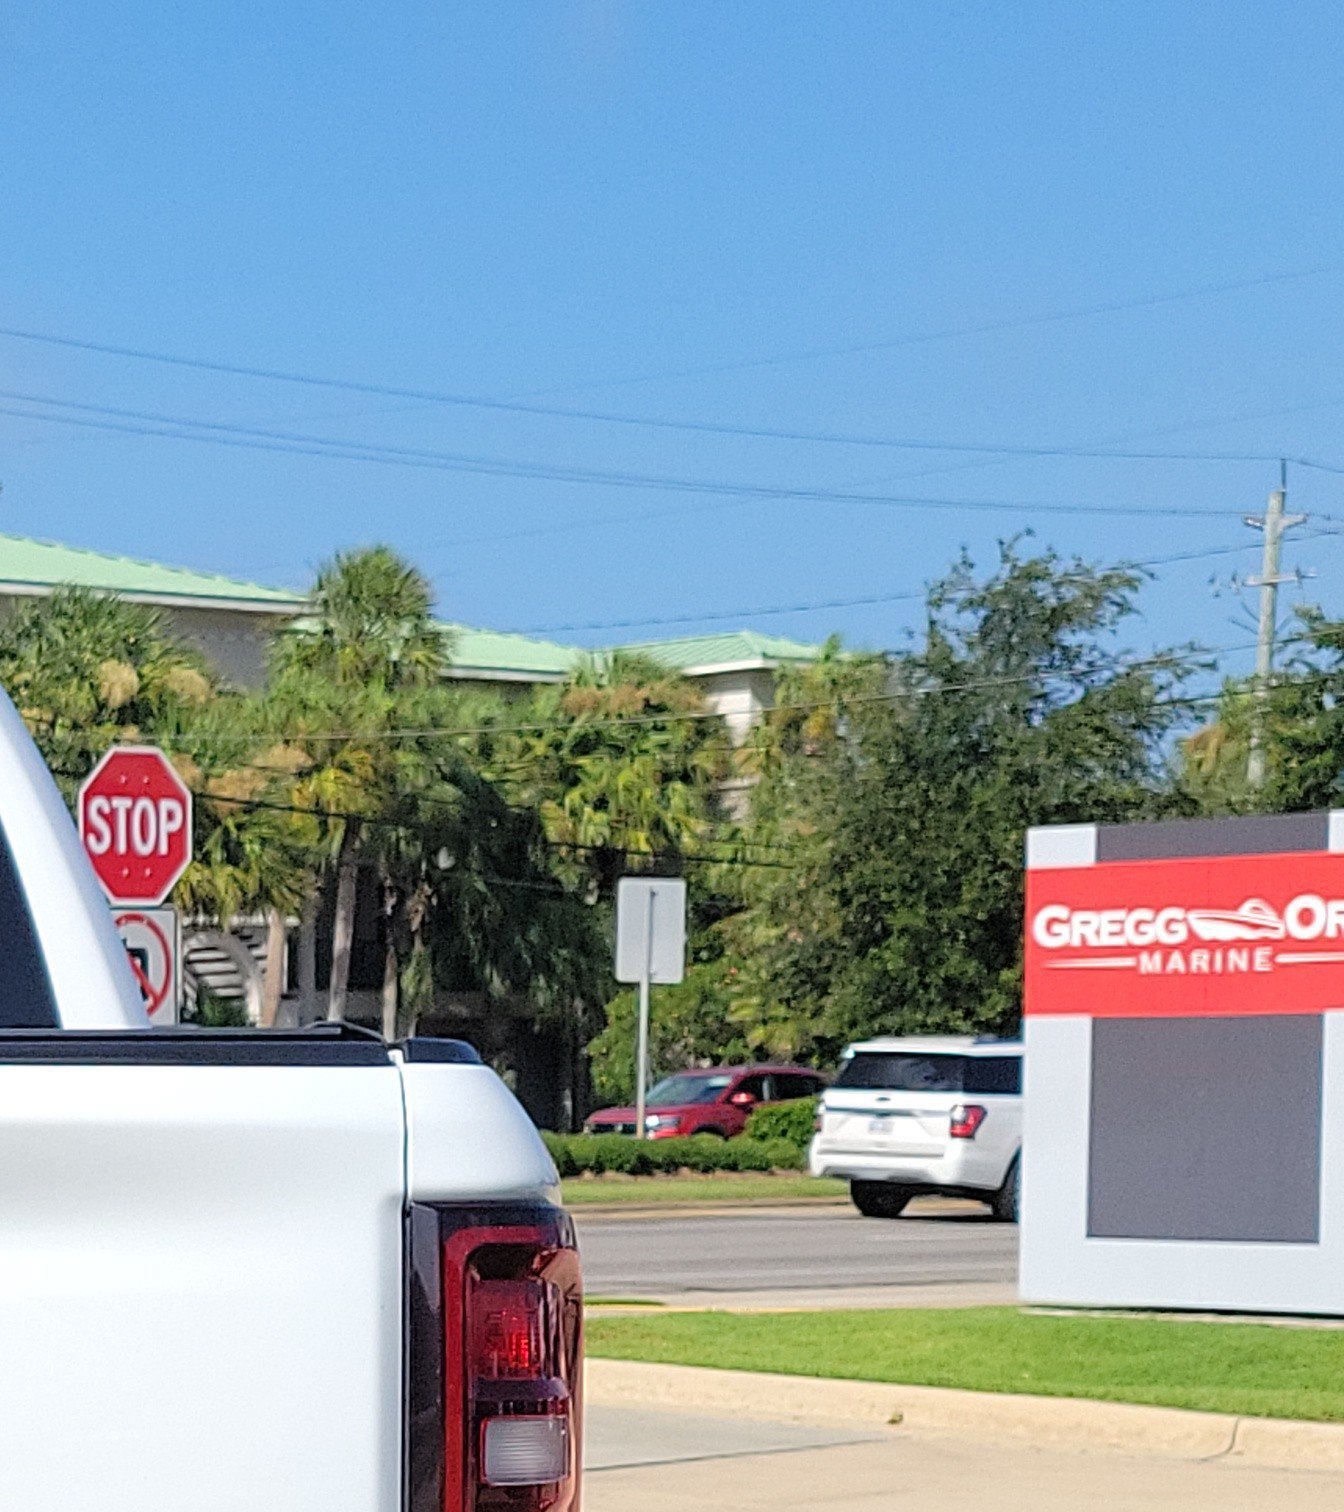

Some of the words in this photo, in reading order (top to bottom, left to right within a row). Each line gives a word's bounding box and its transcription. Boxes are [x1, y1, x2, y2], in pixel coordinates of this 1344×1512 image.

[87, 796, 183, 856] STOP
[1032, 903, 1189, 948] GREGG
[1138, 946, 1274, 975] MARINE
